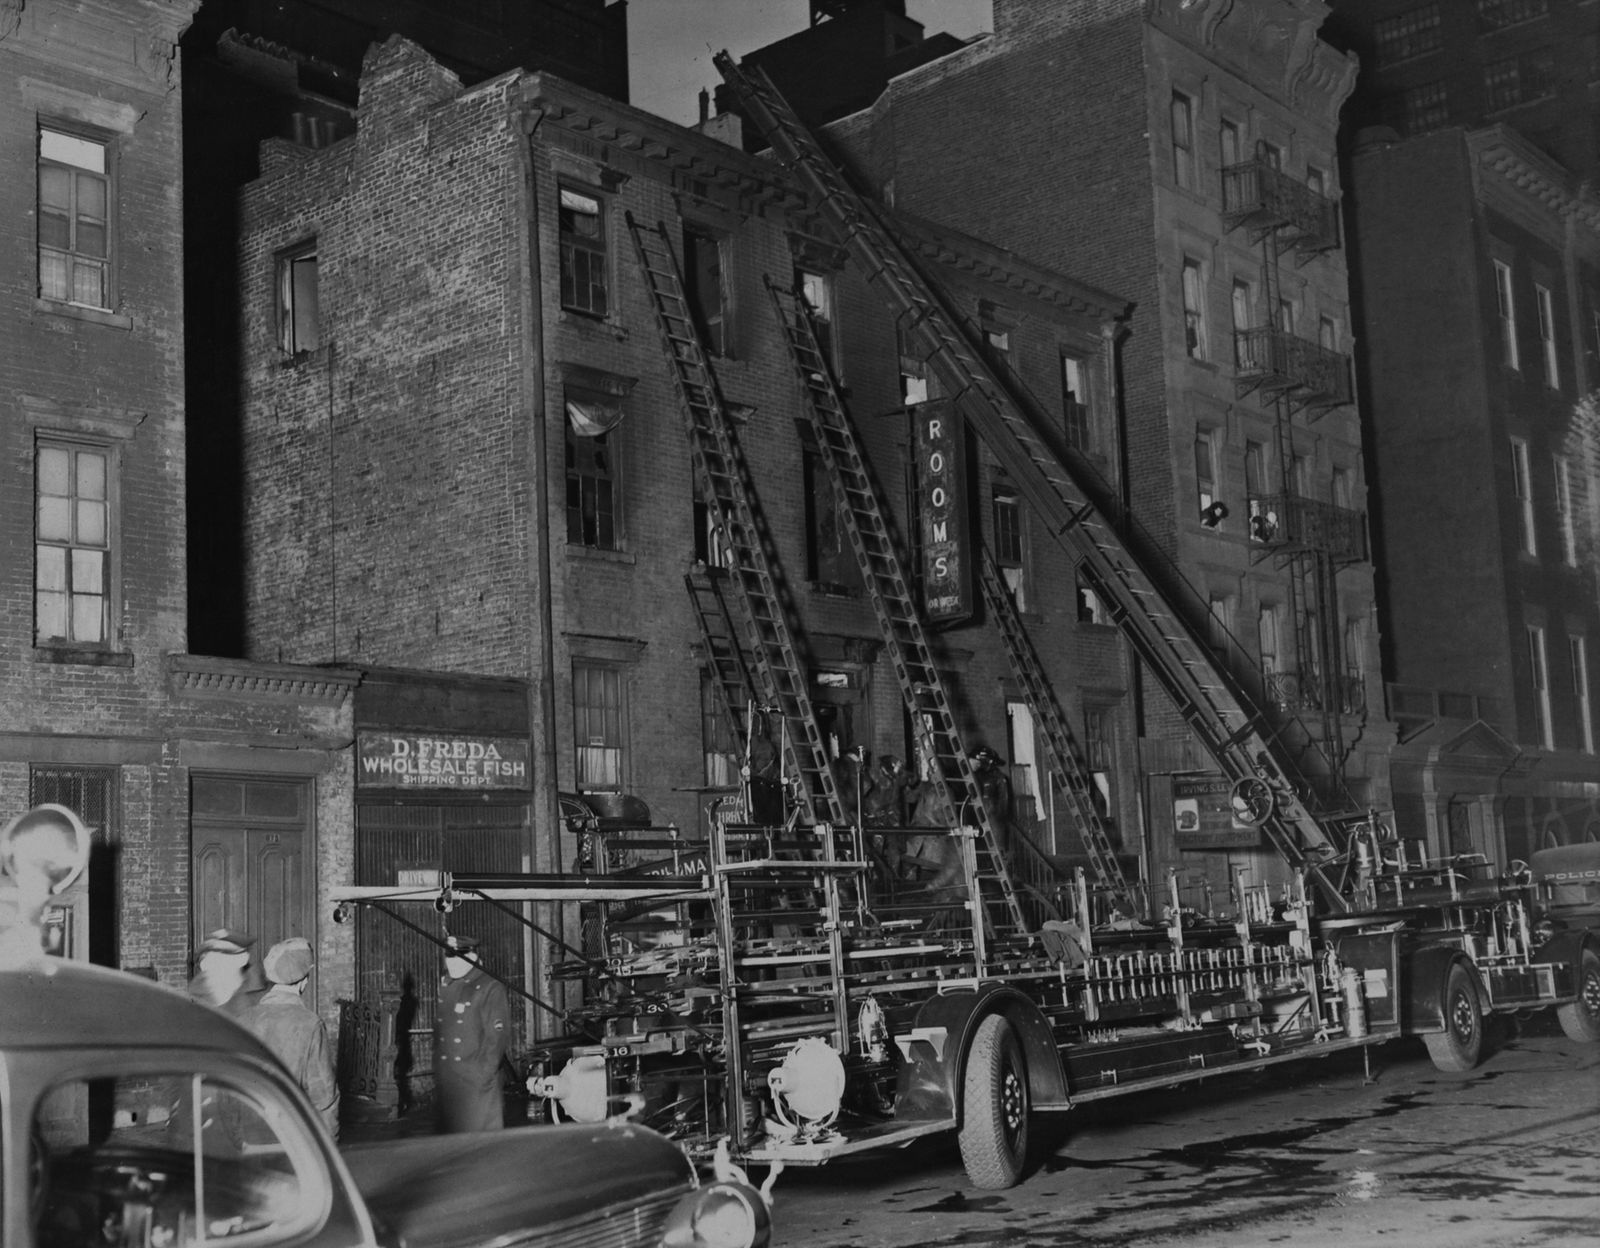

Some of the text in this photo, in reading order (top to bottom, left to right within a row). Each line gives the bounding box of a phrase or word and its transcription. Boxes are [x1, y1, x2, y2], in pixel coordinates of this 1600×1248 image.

[928, 420, 948, 577] ROOMS
[417, 740, 502, 760] FREDA
[363, 757, 525, 777] WHOLESALE FISH
[403, 774, 456, 785] SHIPPING
[613, 1047, 628, 1057] 16
